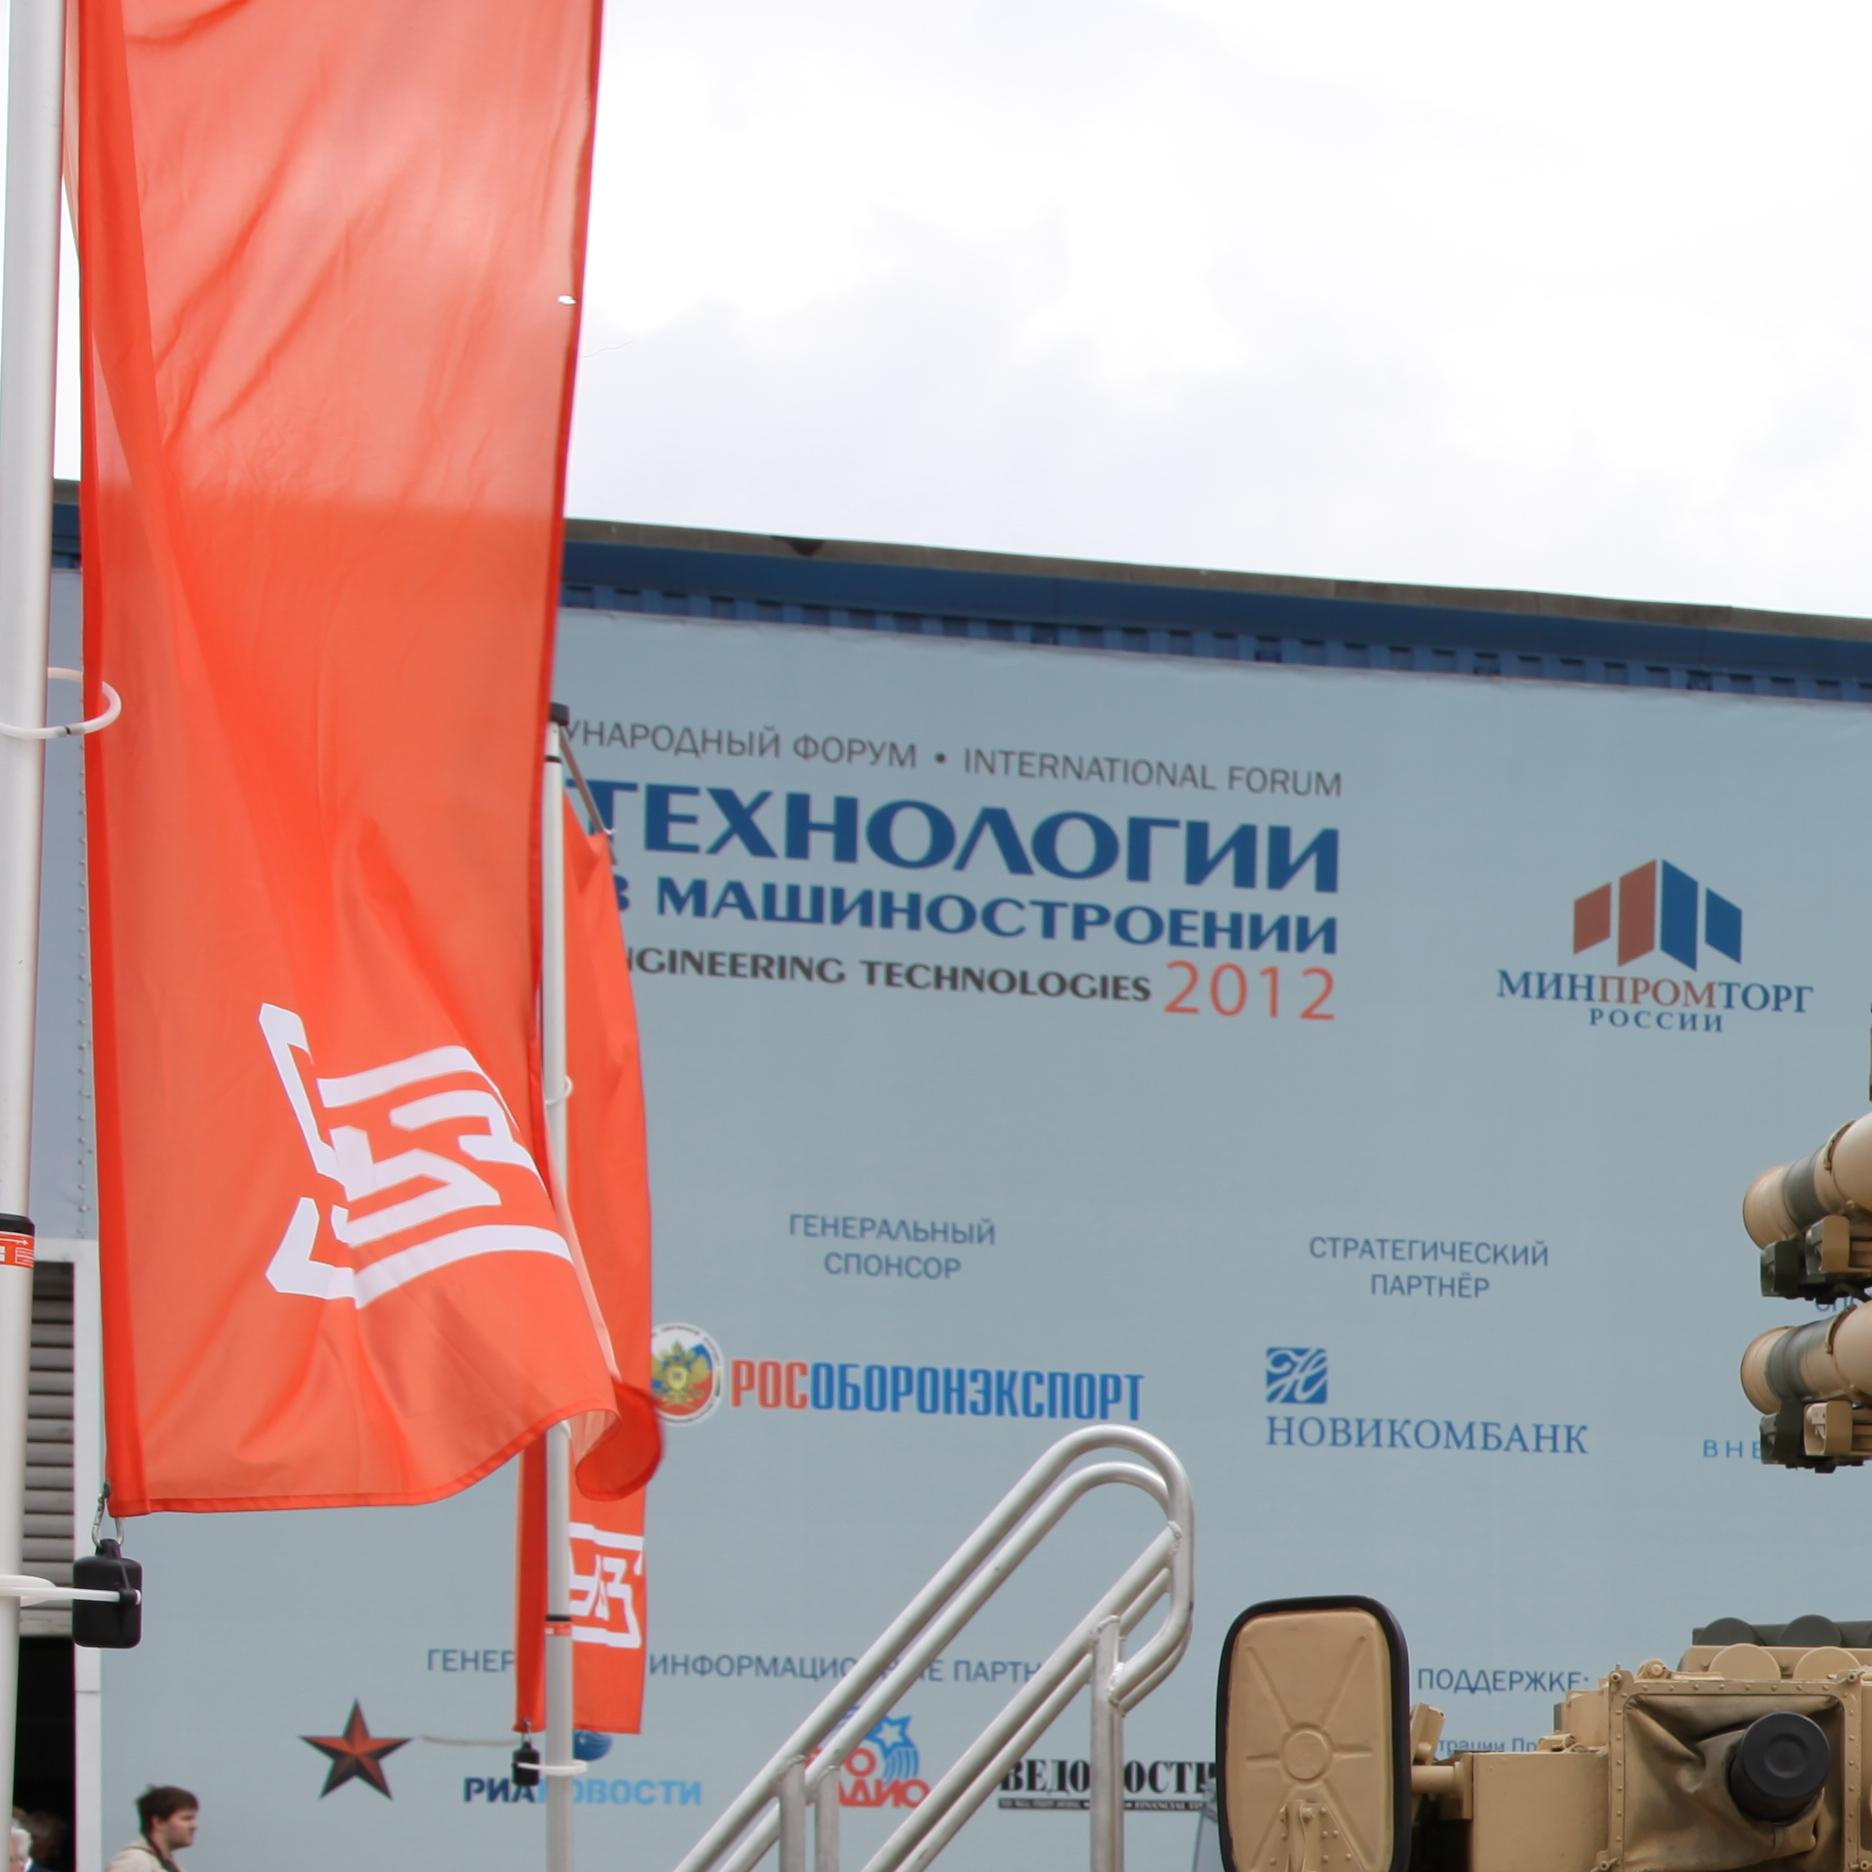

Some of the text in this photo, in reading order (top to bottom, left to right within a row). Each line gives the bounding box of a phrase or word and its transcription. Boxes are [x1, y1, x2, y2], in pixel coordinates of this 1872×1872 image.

[793, 735, 917, 768] ФОРУМ
[965, 748, 1216, 790] INTERNATIONAL
[1228, 766, 1342, 797] FORUM
[565, 777, 1339, 893] ТЕХНОЛОГИИ
[657, 875, 1338, 954] МАШИНОСТРОЕНИИ
[859, 959, 1150, 1001] TECHNOLOGIES
[1164, 960, 1335, 1021] 2012
[1496, 969, 1814, 1013] МИНПРОМТОРГ
[1589, 1008, 1723, 1032] РОССИИ
[789, 1213, 996, 1246] ГЕНЕРАЛЬНЫЙ
[824, 1252, 961, 1279] СПОНСОР
[1309, 1236, 1549, 1266] СТРАТЕГИЧЕСКИЙ
[1370, 1272, 1490, 1298] ПАРТНЁР
[731, 1359, 1145, 1421] РОСОБОРОНЭКСПОРТ
[1265, 1415, 1589, 1454] НОВИКОМБАНК
